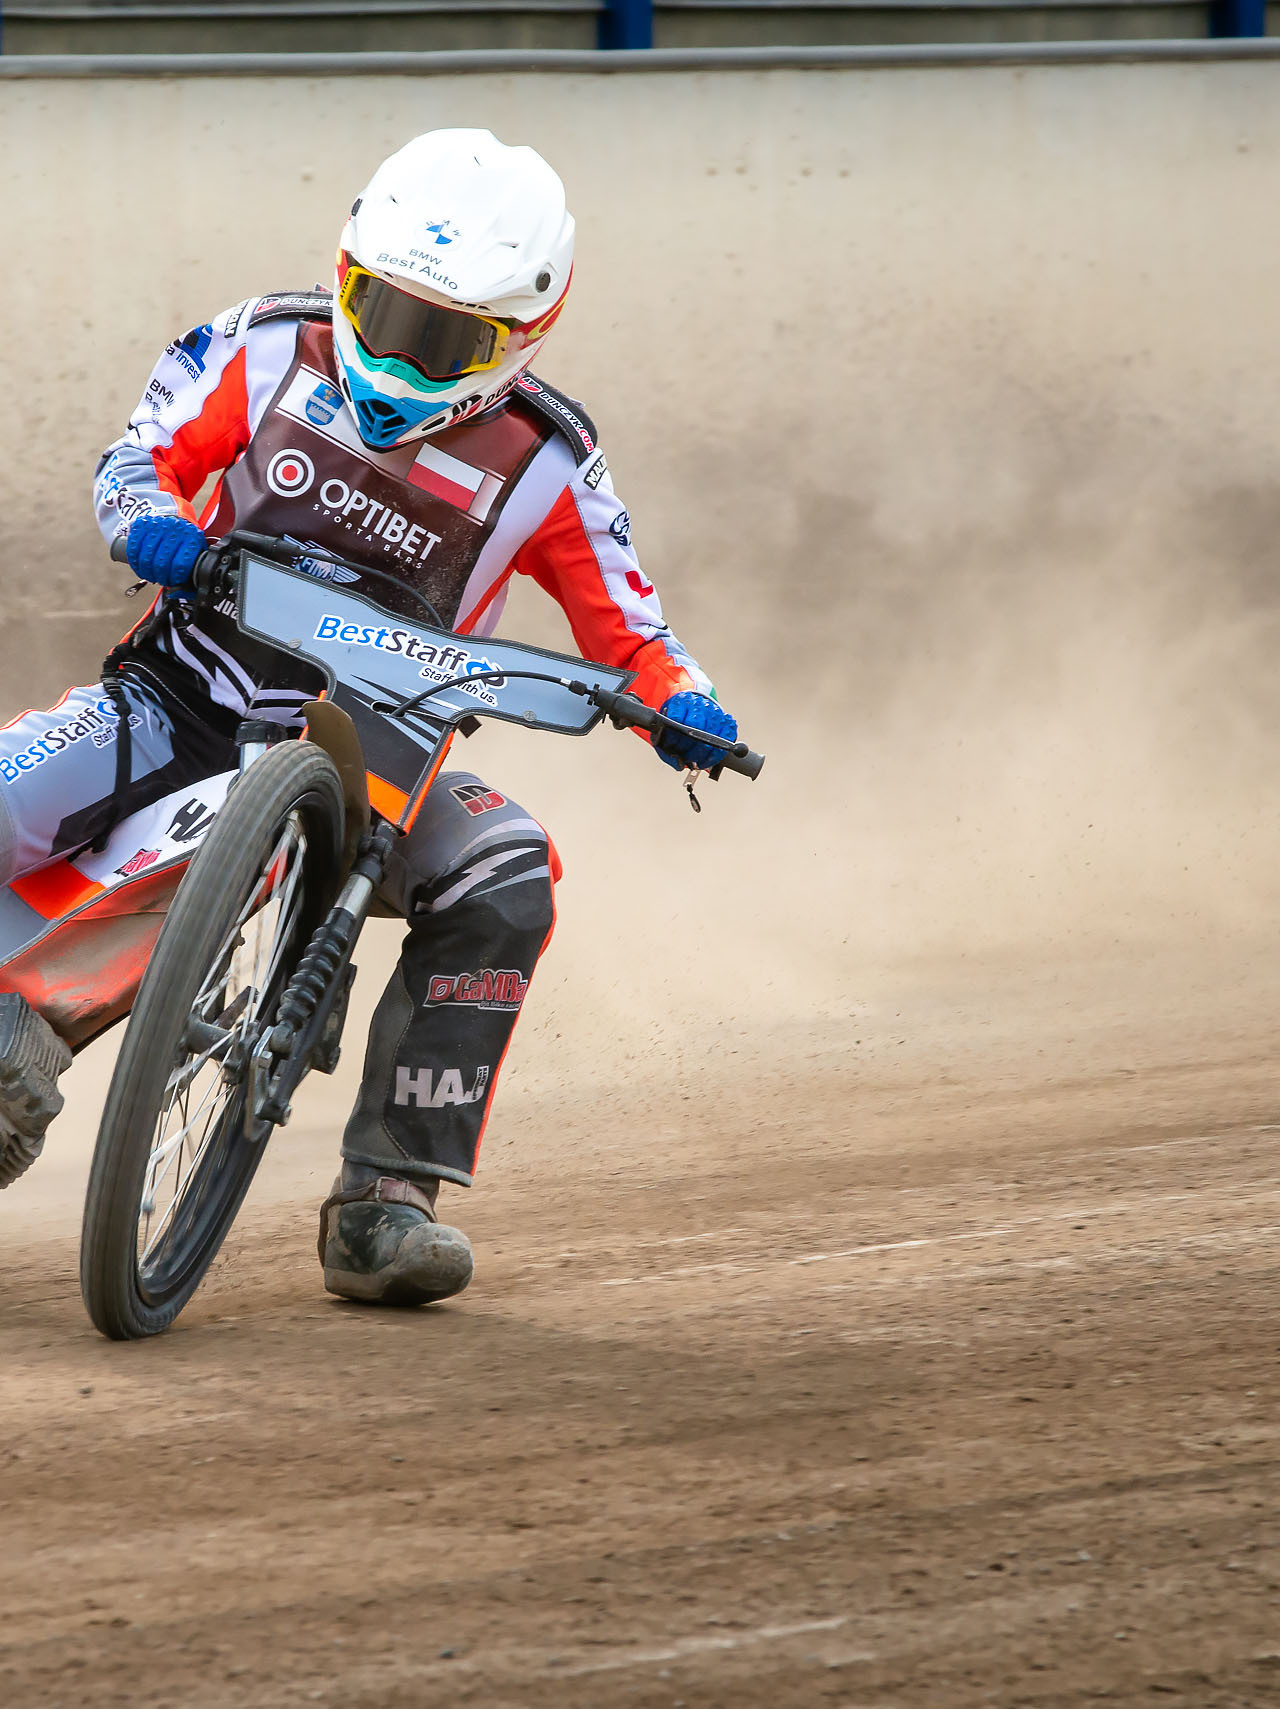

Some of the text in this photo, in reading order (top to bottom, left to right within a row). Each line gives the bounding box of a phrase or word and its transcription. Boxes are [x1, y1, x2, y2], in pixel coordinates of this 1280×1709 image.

[376, 252, 459, 291] Best Auto
[409, 248, 442, 265] BMW
[175, 350, 201, 383] invest
[538, 391, 595, 453] DUNCZYK.COM
[312, 503, 373, 542] SPORTA
[319, 478, 442, 561] OPTIBET
[301, 556, 332, 581] FIM
[317, 616, 468, 672] BestStaff
[421, 667, 455, 684] Staff
[457, 680, 479, 695] ith
[93, 726, 116, 747] Staff
